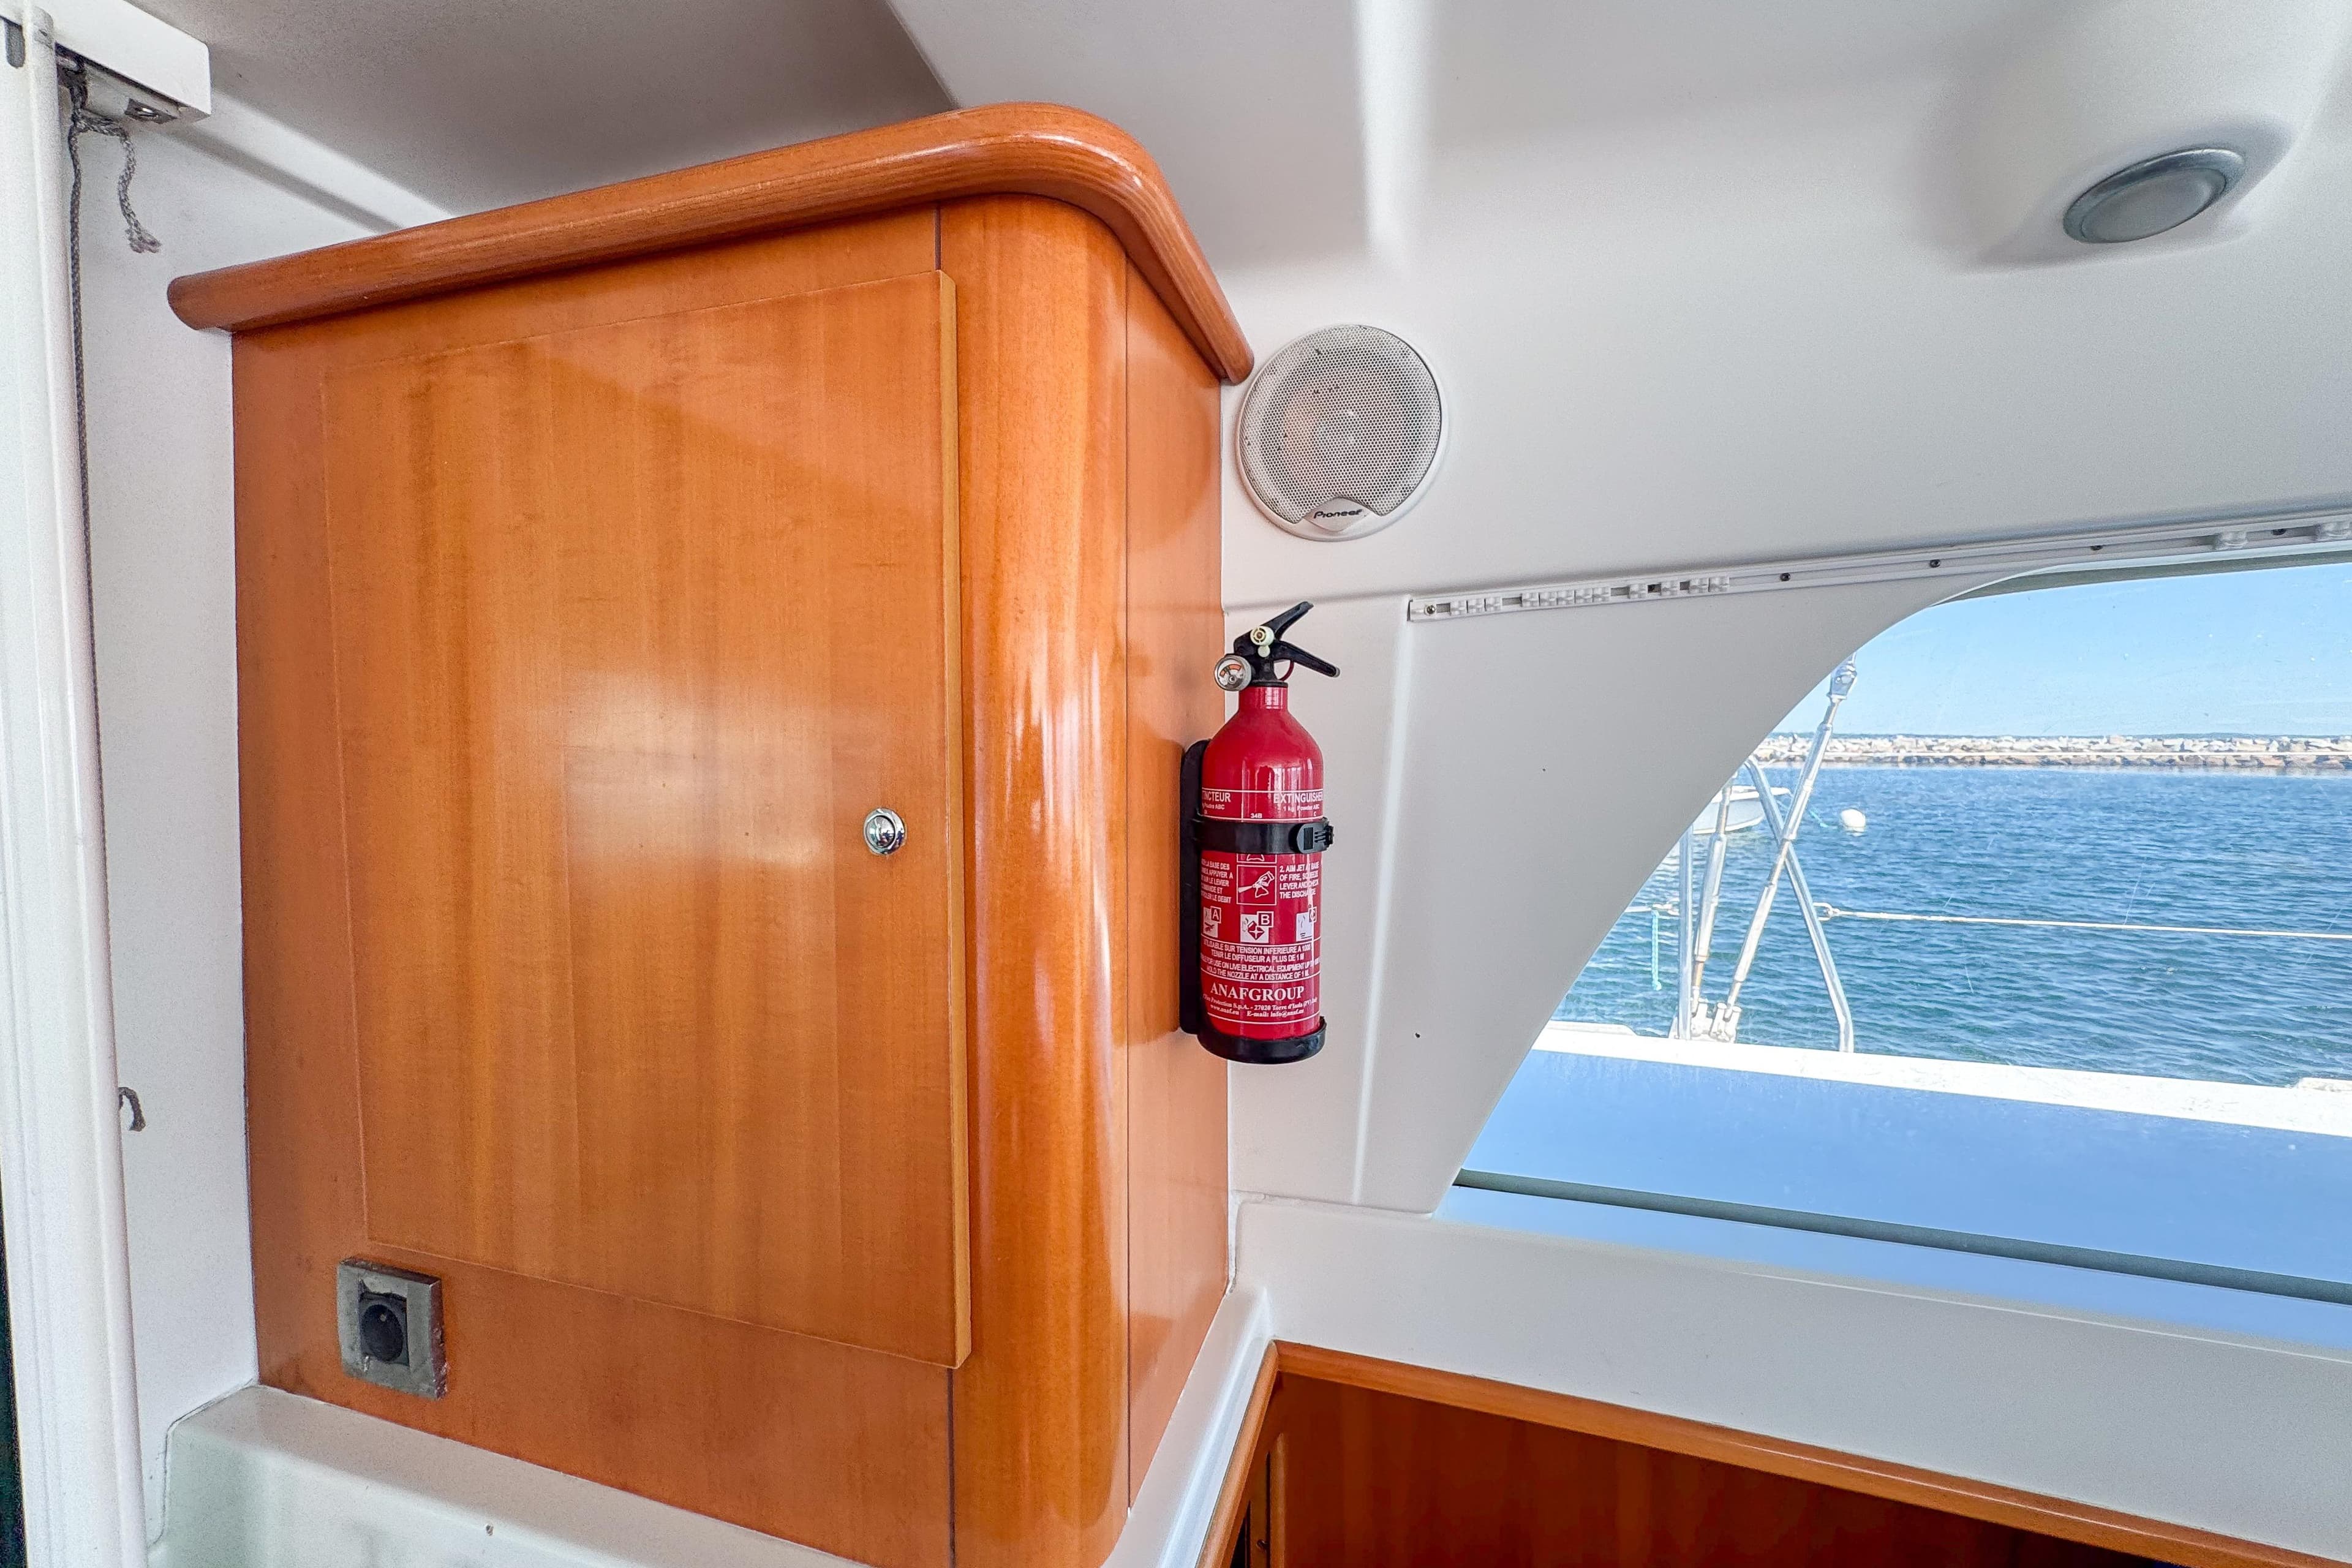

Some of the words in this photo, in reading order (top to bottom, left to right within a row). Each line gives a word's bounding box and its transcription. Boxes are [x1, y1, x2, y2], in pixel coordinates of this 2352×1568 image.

[1313, 509, 1363, 519] Pioneer
[1212, 909, 1219, 919] A
[1261, 914, 1270, 925] B
[1237, 946, 1262, 954] TENSION
[1264, 945, 1297, 955] INFERIEURE
[1211, 949, 1224, 958] TENIR
[1232, 954, 1265, 963] DIFFUSEUR
[1241, 964, 1276, 973] ELECTRICAL
[1217, 968, 1226, 976] THE
[1227, 971, 1250, 979] NOZZLE
[1265, 972, 1293, 981] DISTANCE
[1210, 982, 1305, 1001] ANAFGROUP
